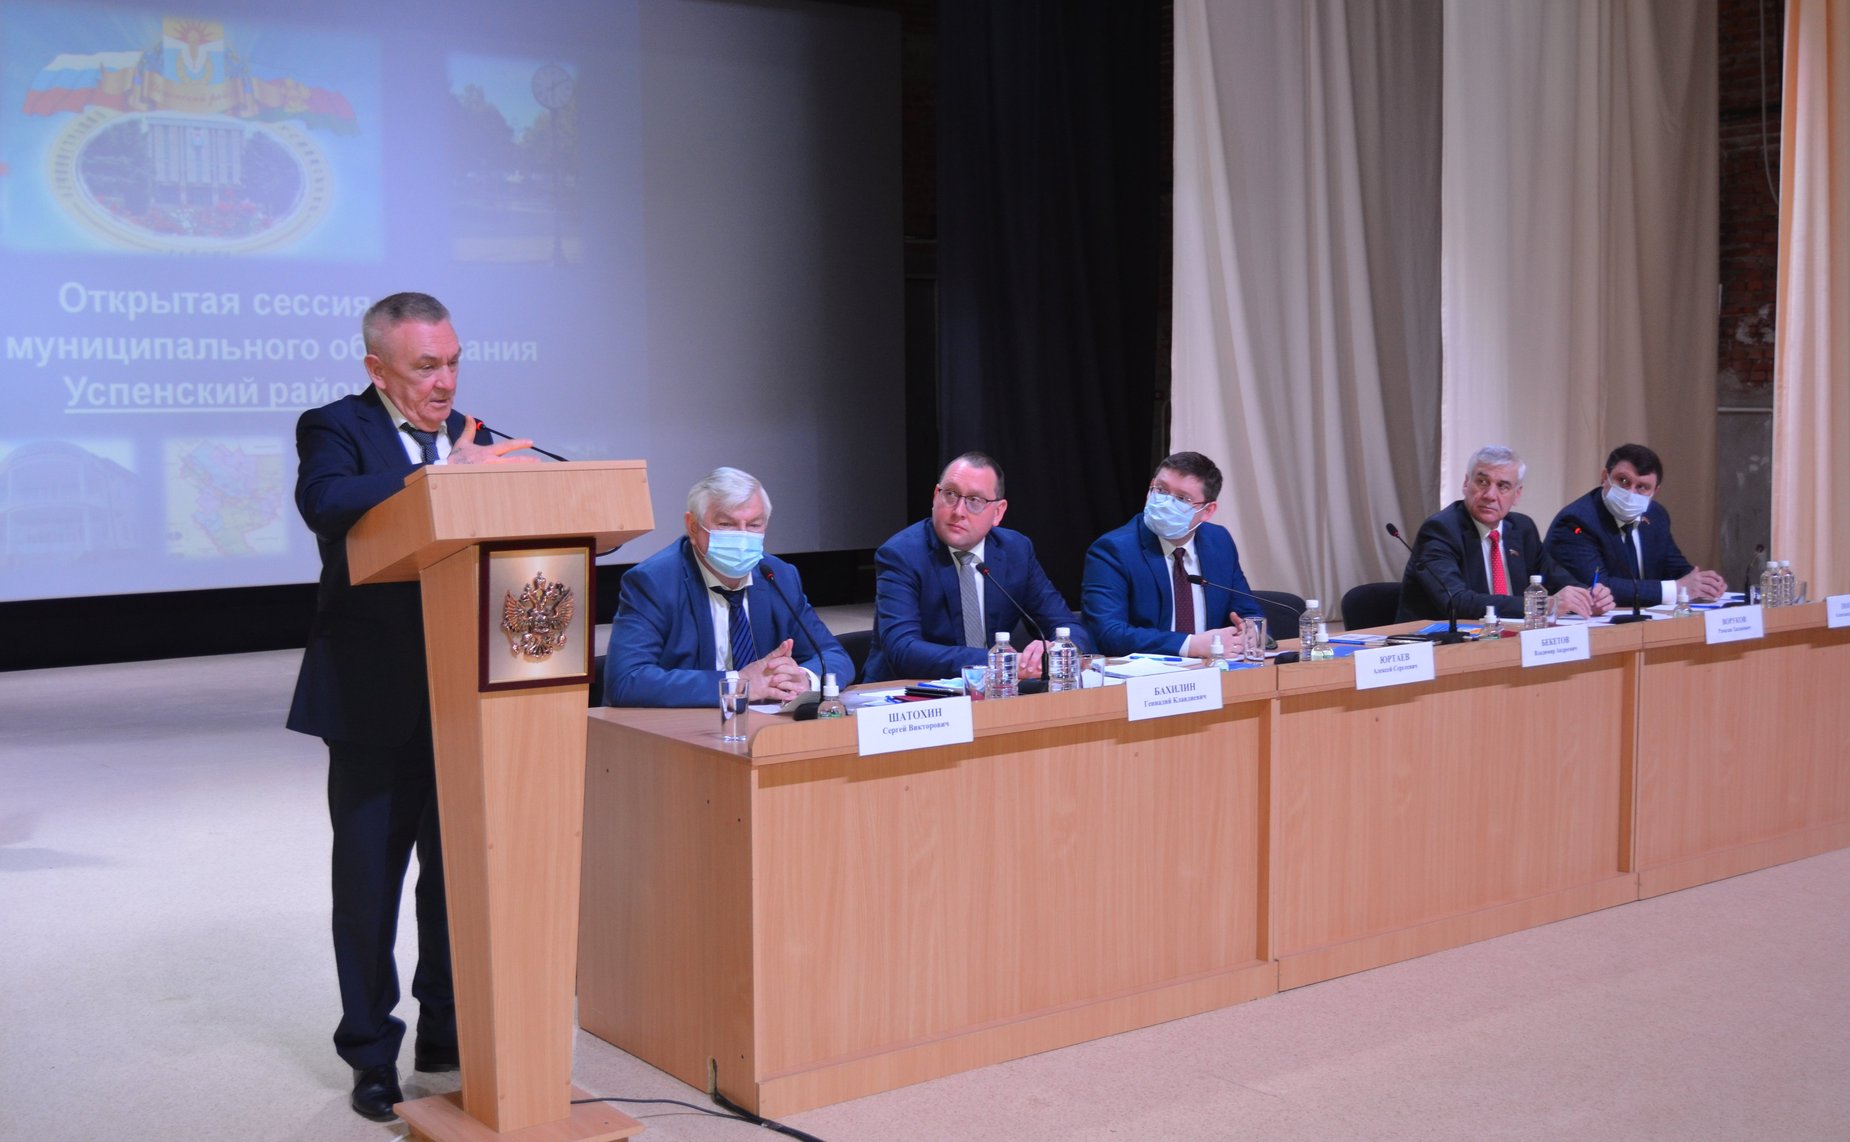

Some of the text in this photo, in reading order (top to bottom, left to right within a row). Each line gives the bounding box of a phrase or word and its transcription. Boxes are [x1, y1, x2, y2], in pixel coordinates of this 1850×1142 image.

[58, 281, 371, 321] Открытая сессия
[6, 335, 320, 367] муниципального
[63, 376, 260, 407] Успенский
[1541, 636, 1570, 646] БЕКЕТОВ
[1380, 653, 1410, 664] ЮРТАЕВ
[1154, 683, 1196, 696] БАХИЛИН
[1144, 697, 1172, 707] Геннадий
[888, 707, 942, 722] ШАТОХИН
[882, 721, 950, 735] Сергей Викторович
